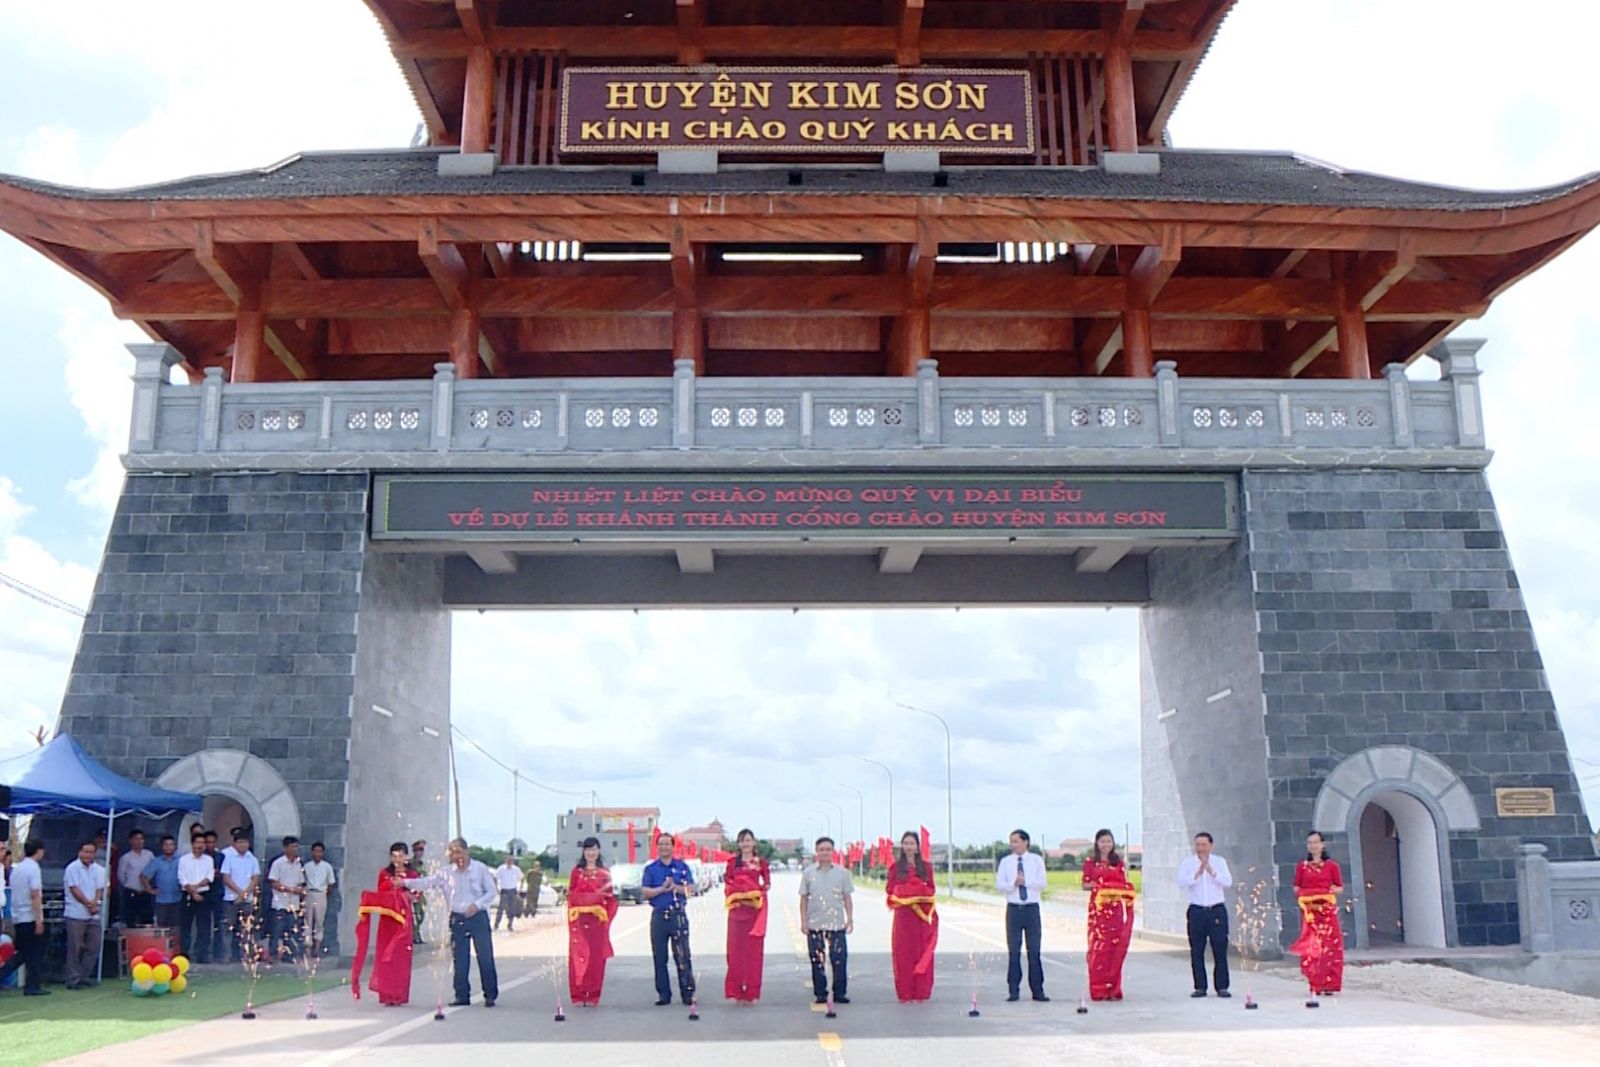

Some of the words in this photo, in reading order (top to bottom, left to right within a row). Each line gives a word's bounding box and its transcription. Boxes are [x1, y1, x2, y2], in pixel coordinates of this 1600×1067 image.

[606, 74, 773, 114] HUYỆN
[788, 81, 881, 110] KIM
[895, 79, 988, 110] SƠN
[580, 117, 670, 140] KÍNH
[684, 116, 786, 140] CHÀO
[799, 116, 875, 141] QUÝ
[887, 118, 1015, 141] KHÁCH
[531, 486, 616, 506] NHIỆT
[623, 486, 684, 506] LIỆT
[690, 486, 767, 503] CHÀO
[774, 485, 854, 503] MỪNG
[860, 485, 918, 503] QUÝ
[926, 488, 956, 506] VỊ
[963, 488, 1013, 505] ĐẠI
[1019, 481, 1082, 503] BIỂU
[576, 508, 675, 527] KHÁNH
[682, 508, 779, 527] THÀNH
[868, 508, 944, 526] CHÀO
[951, 507, 1046, 527] HUYỆN
[1054, 510, 1107, 526] KIM
[1114, 510, 1168, 526] SƠN
